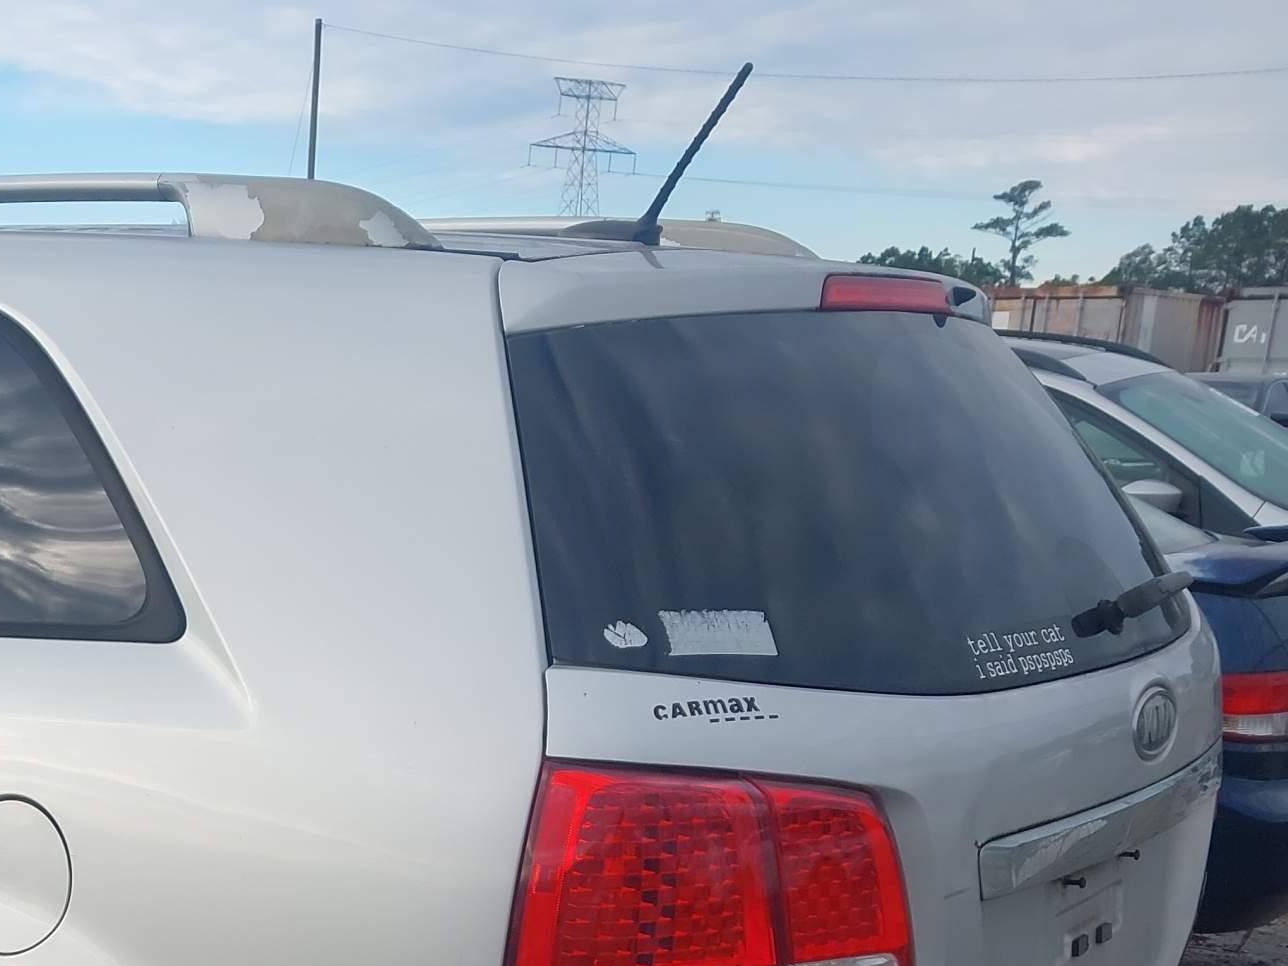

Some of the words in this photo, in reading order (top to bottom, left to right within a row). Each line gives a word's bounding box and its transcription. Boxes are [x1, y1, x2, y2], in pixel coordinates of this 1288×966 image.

[967, 632, 1002, 655] tell
[1003, 630, 1039, 652] your
[1041, 624, 1064, 643] cat
[975, 658, 986, 678] i
[987, 654, 1018, 677] said
[1019, 648, 1074, 674] pspspsps
